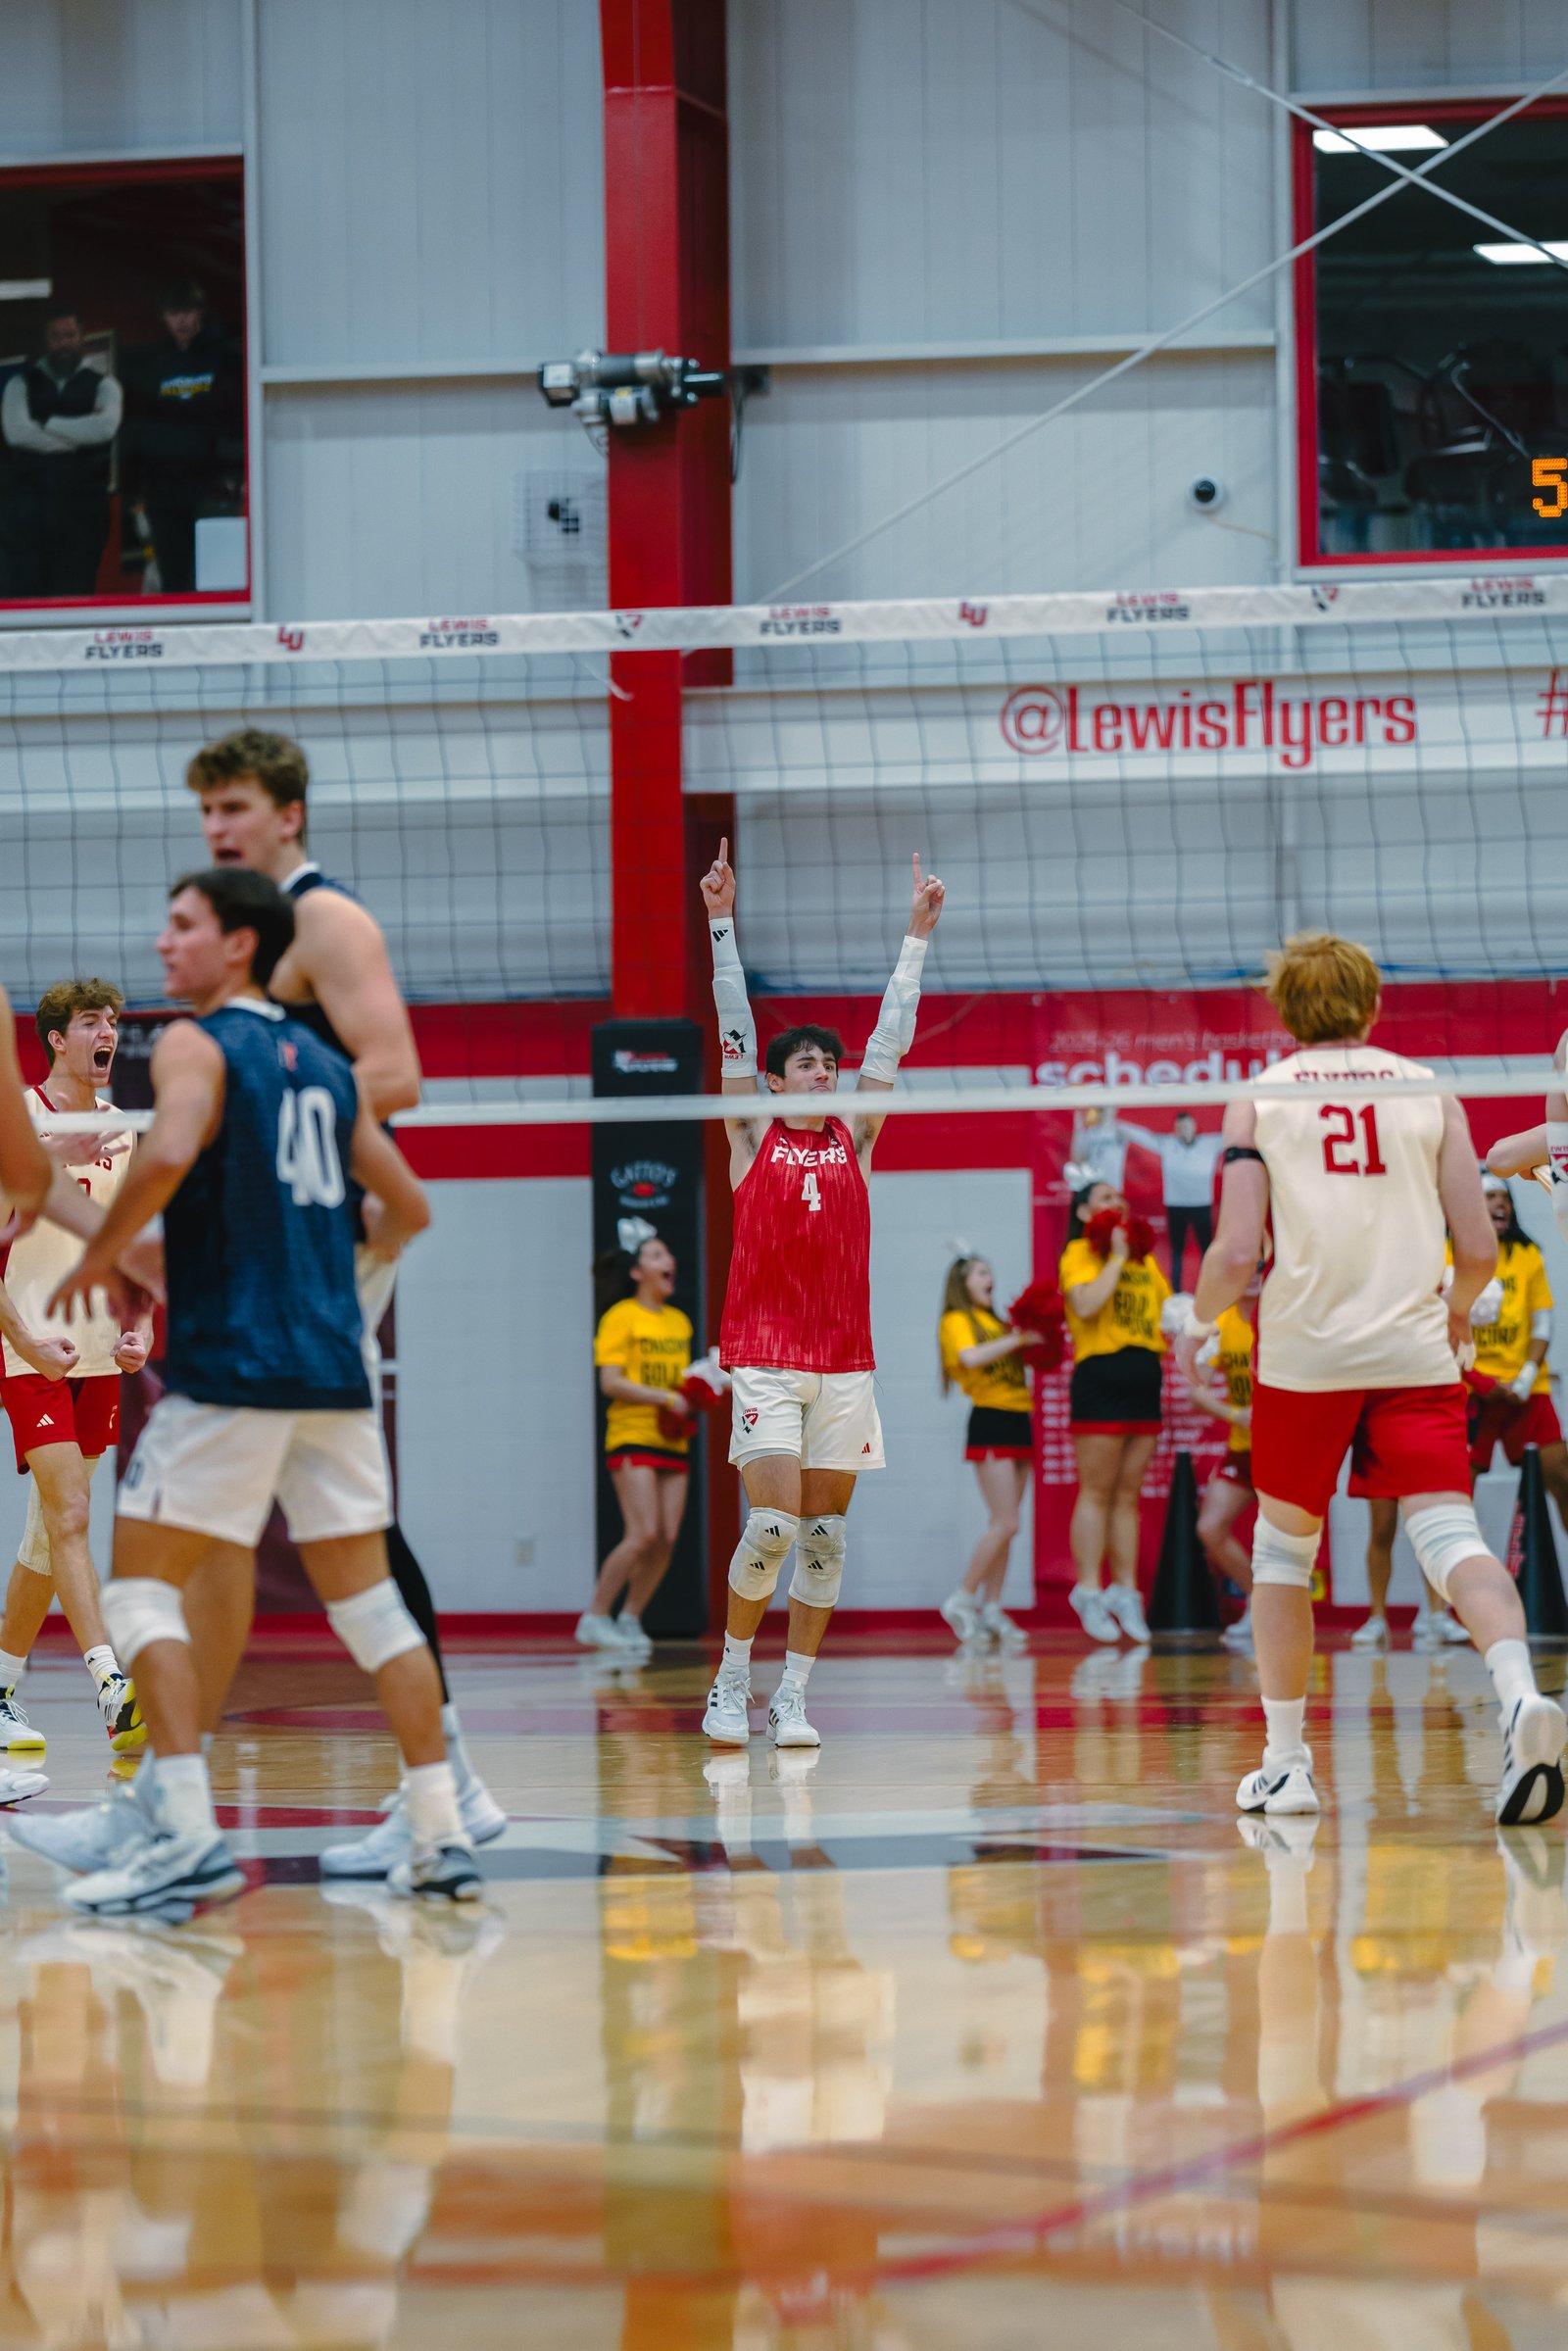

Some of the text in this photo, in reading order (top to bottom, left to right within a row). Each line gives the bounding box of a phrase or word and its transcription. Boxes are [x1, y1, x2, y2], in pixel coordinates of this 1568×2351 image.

[1533, 458, 1567, 517] 5
[1115, 592, 1178, 607] LEWIS
[1457, 591, 1545, 609] FLYERS
[769, 606, 830, 619] LEWIS
[1105, 605, 1190, 622] FLYERS
[428, 617, 488, 632] LEWIS
[760, 619, 841, 636] FLYERS
[94, 630, 153, 643] LEWIS
[419, 632, 499, 648] FLYERS
[85, 643, 164, 660] FLYERS
[1000, 680, 1416, 768] @LewisFlyers
[276, 1085, 345, 1208] 40
[1319, 1104, 1388, 1175] 21
[770, 1145, 848, 1167] FLYERS
[801, 1172, 821, 1211] 4
